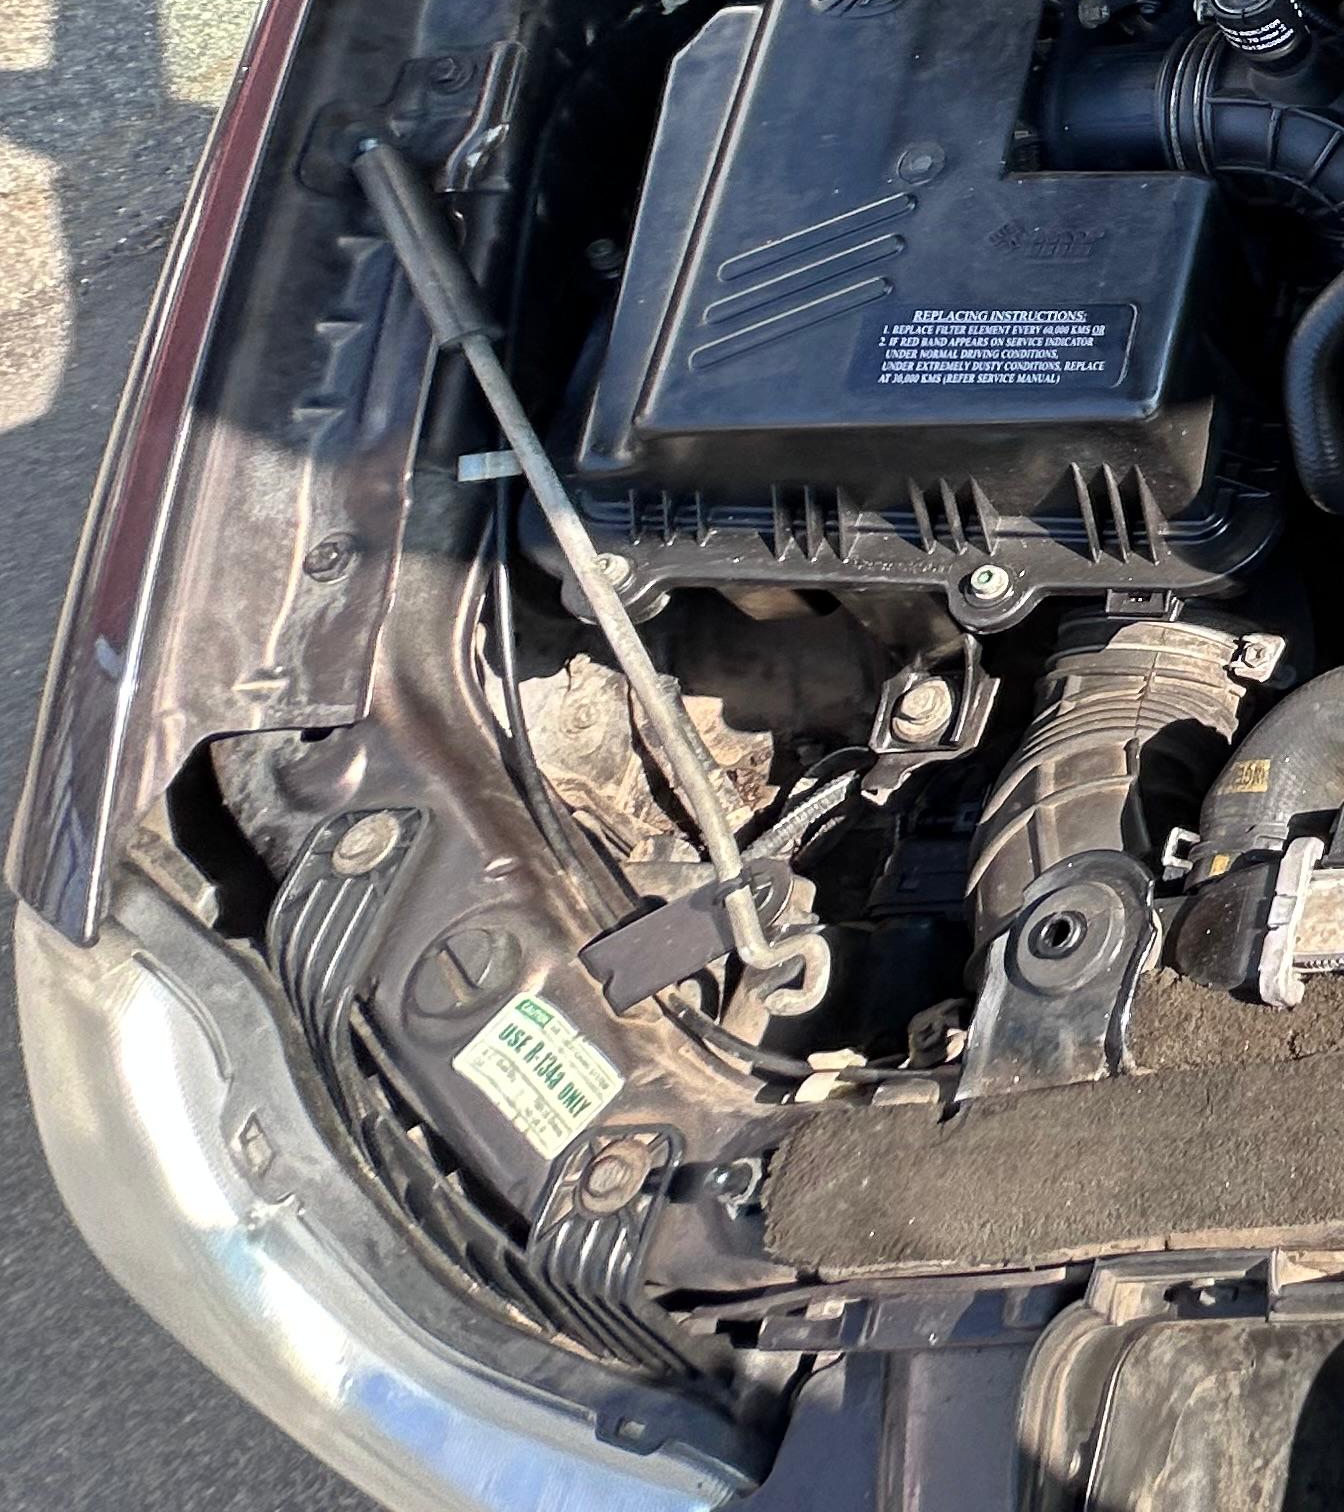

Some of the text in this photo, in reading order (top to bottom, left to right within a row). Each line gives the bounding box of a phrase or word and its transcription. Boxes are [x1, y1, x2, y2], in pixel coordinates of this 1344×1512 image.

[912, 310, 1087, 323] REPLACING INSTRUCTIONS:
[892, 325, 934, 335] REPLACE
[935, 325, 967, 335] FILTER
[968, 325, 1011, 335] ELEMENT
[1012, 325, 1042, 335] EVERY
[1070, 325, 1092, 335] KMS
[1091, 325, 1106, 336] OR
[888, 337, 899, 347] IF
[900, 337, 920, 347] RED
[921, 337, 948, 347] BAND
[948, 337, 990, 347] APPEARS
[990, 337, 1005, 347] ON
[1005, 337, 1044, 347] SERVICE
[1044, 337, 1094, 347] INDICATOR
[885, 349, 918, 359] UNDER
[920, 349, 959, 359] NORMAL
[960, 349, 1000, 359] DRIVING
[882, 361, 914, 371] UNDER
[915, 361, 972, 371] EXTREMELY
[971, 361, 1004, 371] DUSTY
[1063, 361, 1106, 371] REPLACE
[877, 374, 892, 384] AT
[920, 374, 942, 384] KMS
[942, 374, 975, 385] (REFER
[976, 374, 1016, 384] SERVICE
[1016, 374, 1061, 385] MANUAL)
[498, 1023, 533, 1053] USE
[523, 1042, 566, 1090] R-134a
[557, 1082, 592, 1118] ONLY
